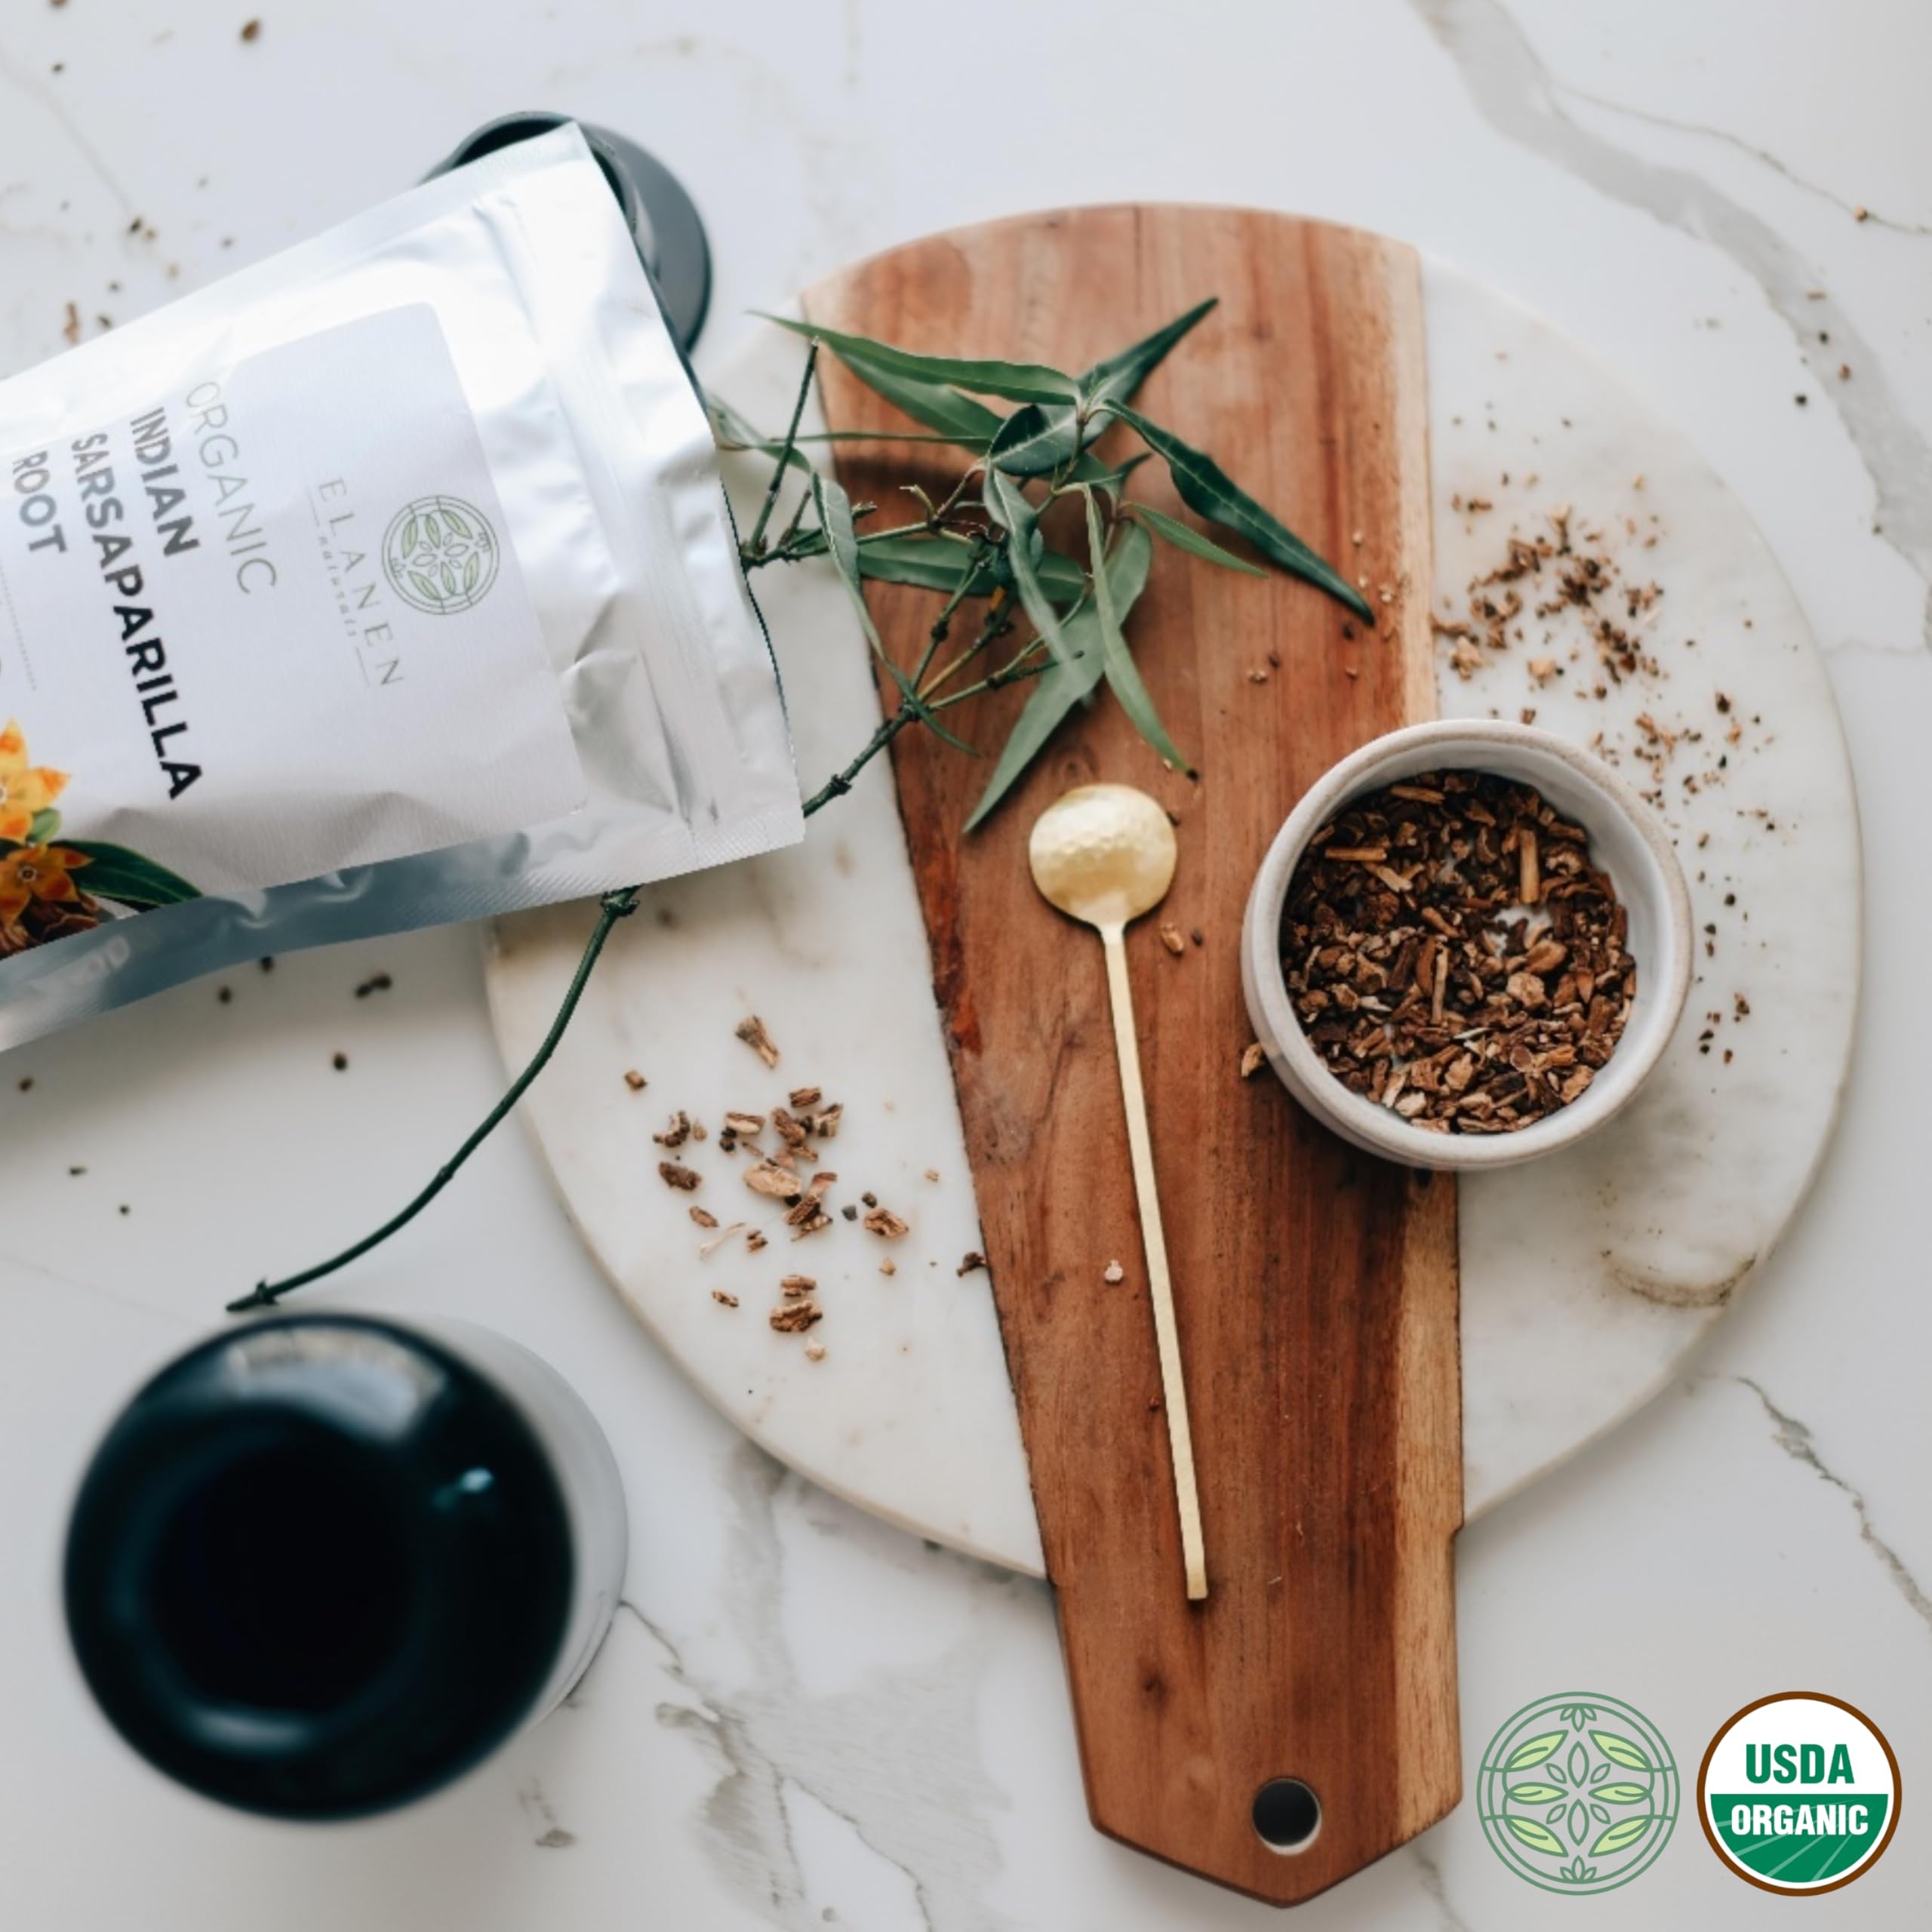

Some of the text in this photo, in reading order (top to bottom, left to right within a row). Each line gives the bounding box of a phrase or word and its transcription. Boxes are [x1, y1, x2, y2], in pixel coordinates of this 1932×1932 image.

[13, 451, 67, 553] ROOT
[130, 408, 200, 557] INDIAN
[186, 381, 277, 594] ORGANIC
[318, 478, 405, 685] ELANEN
[72, 432, 202, 799] SARSAPARILLA
